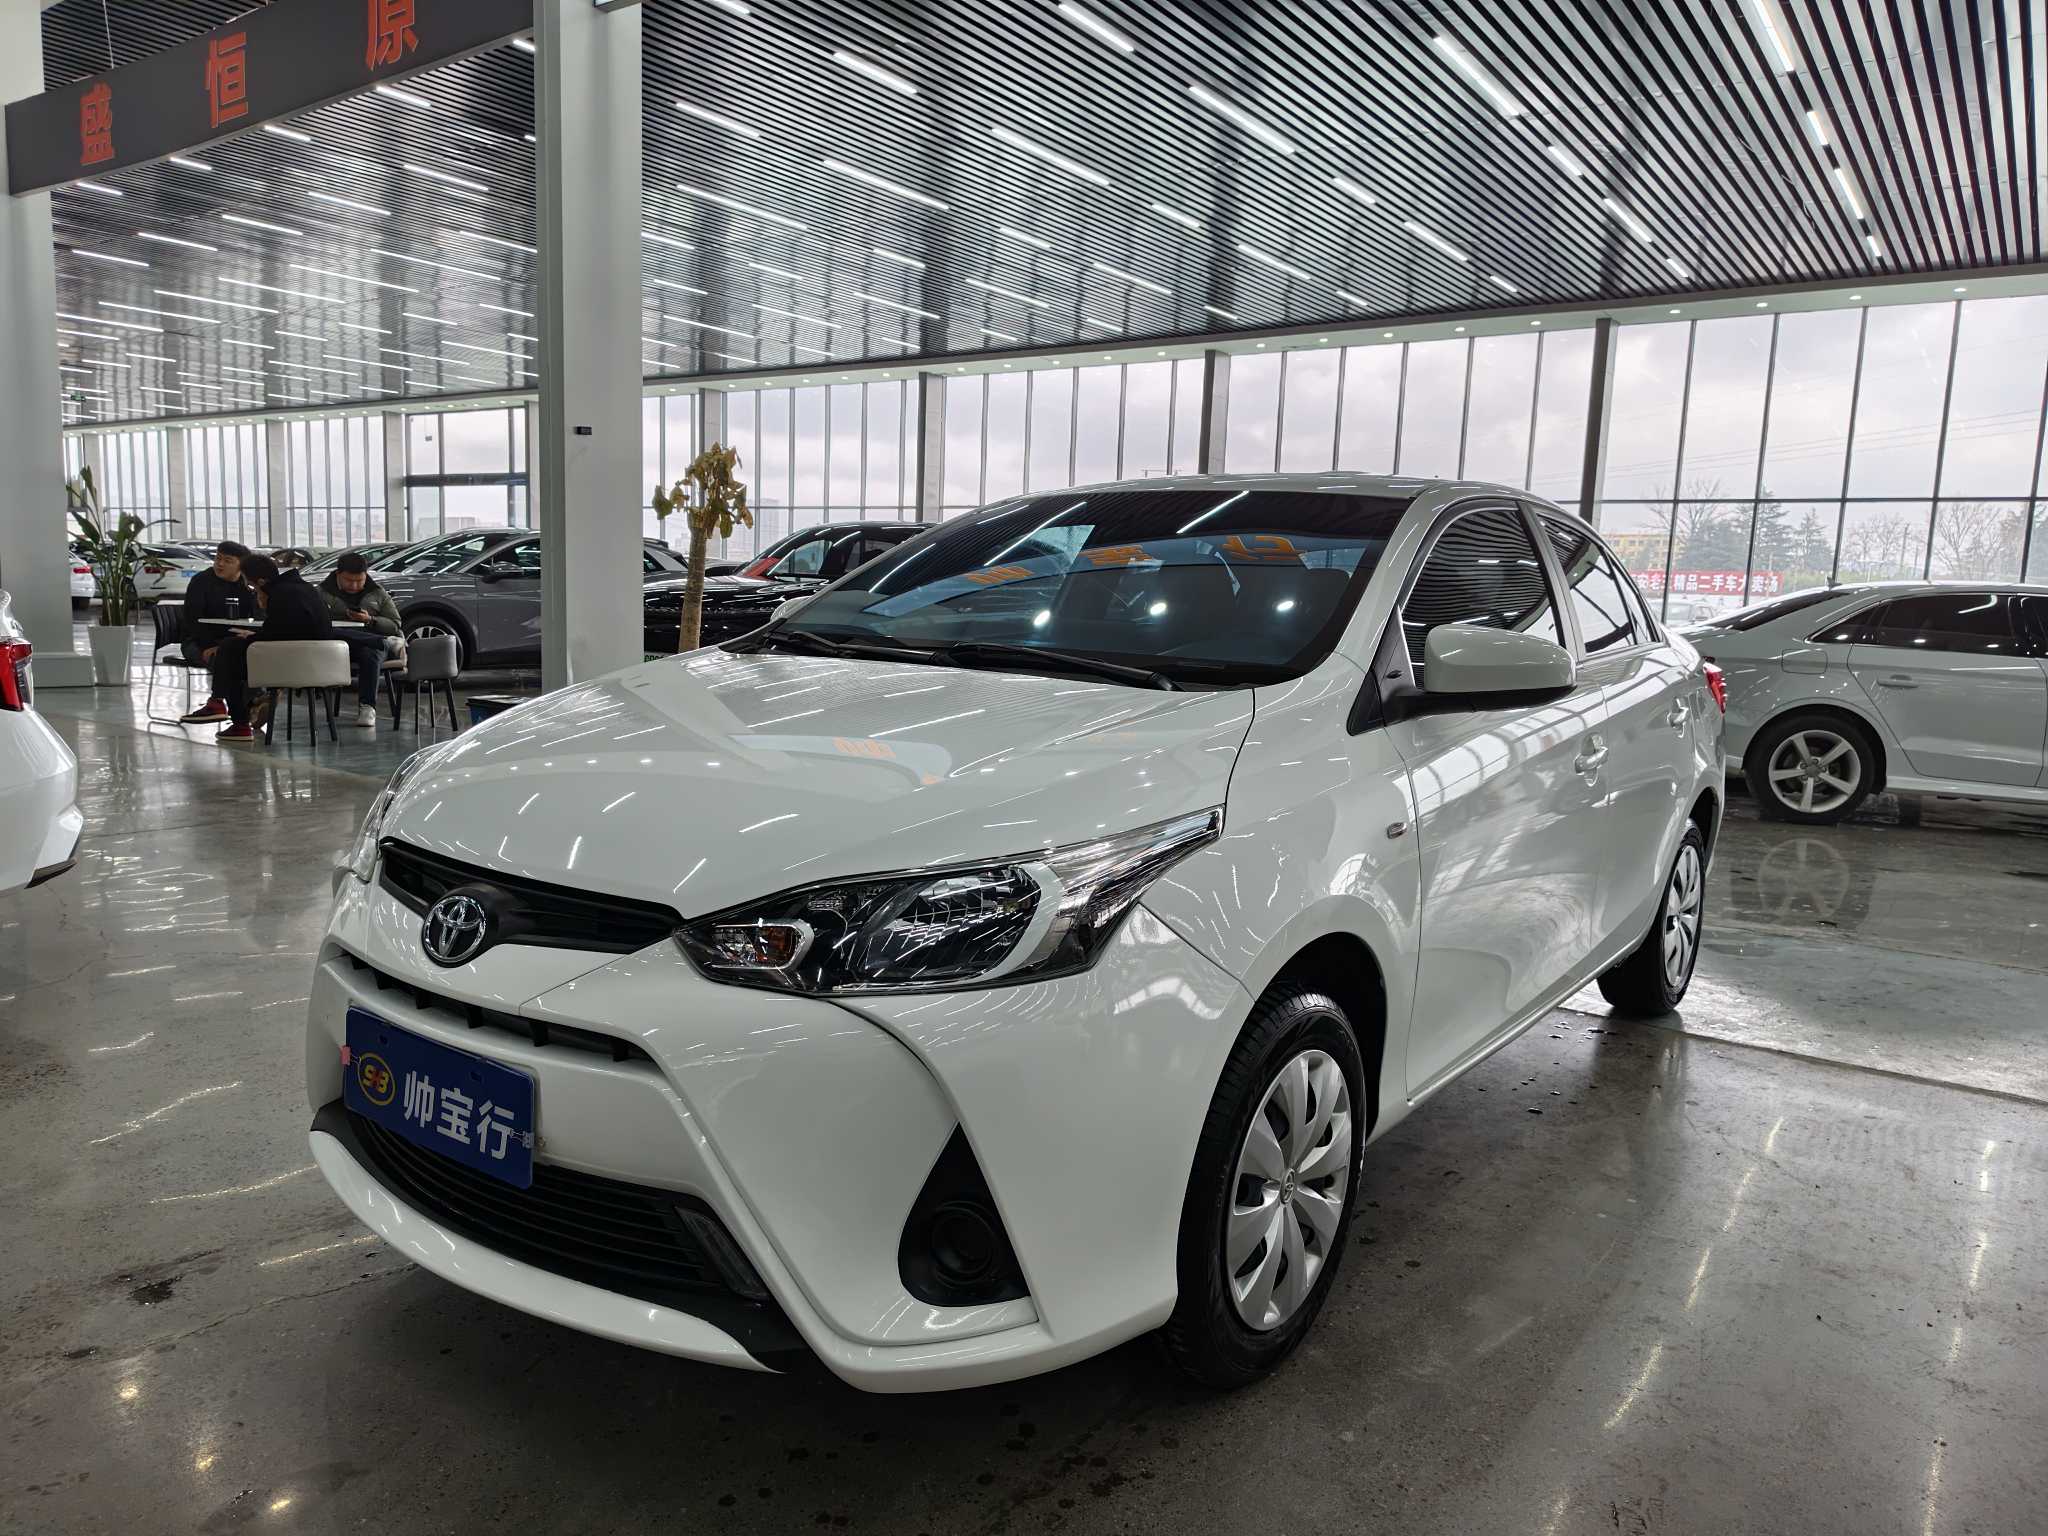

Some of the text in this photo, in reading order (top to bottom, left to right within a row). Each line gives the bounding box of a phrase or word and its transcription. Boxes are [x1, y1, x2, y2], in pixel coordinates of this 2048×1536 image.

[80, 0, 419, 165] 盛恒原
[403, 1070, 515, 1160] 帅宝行
